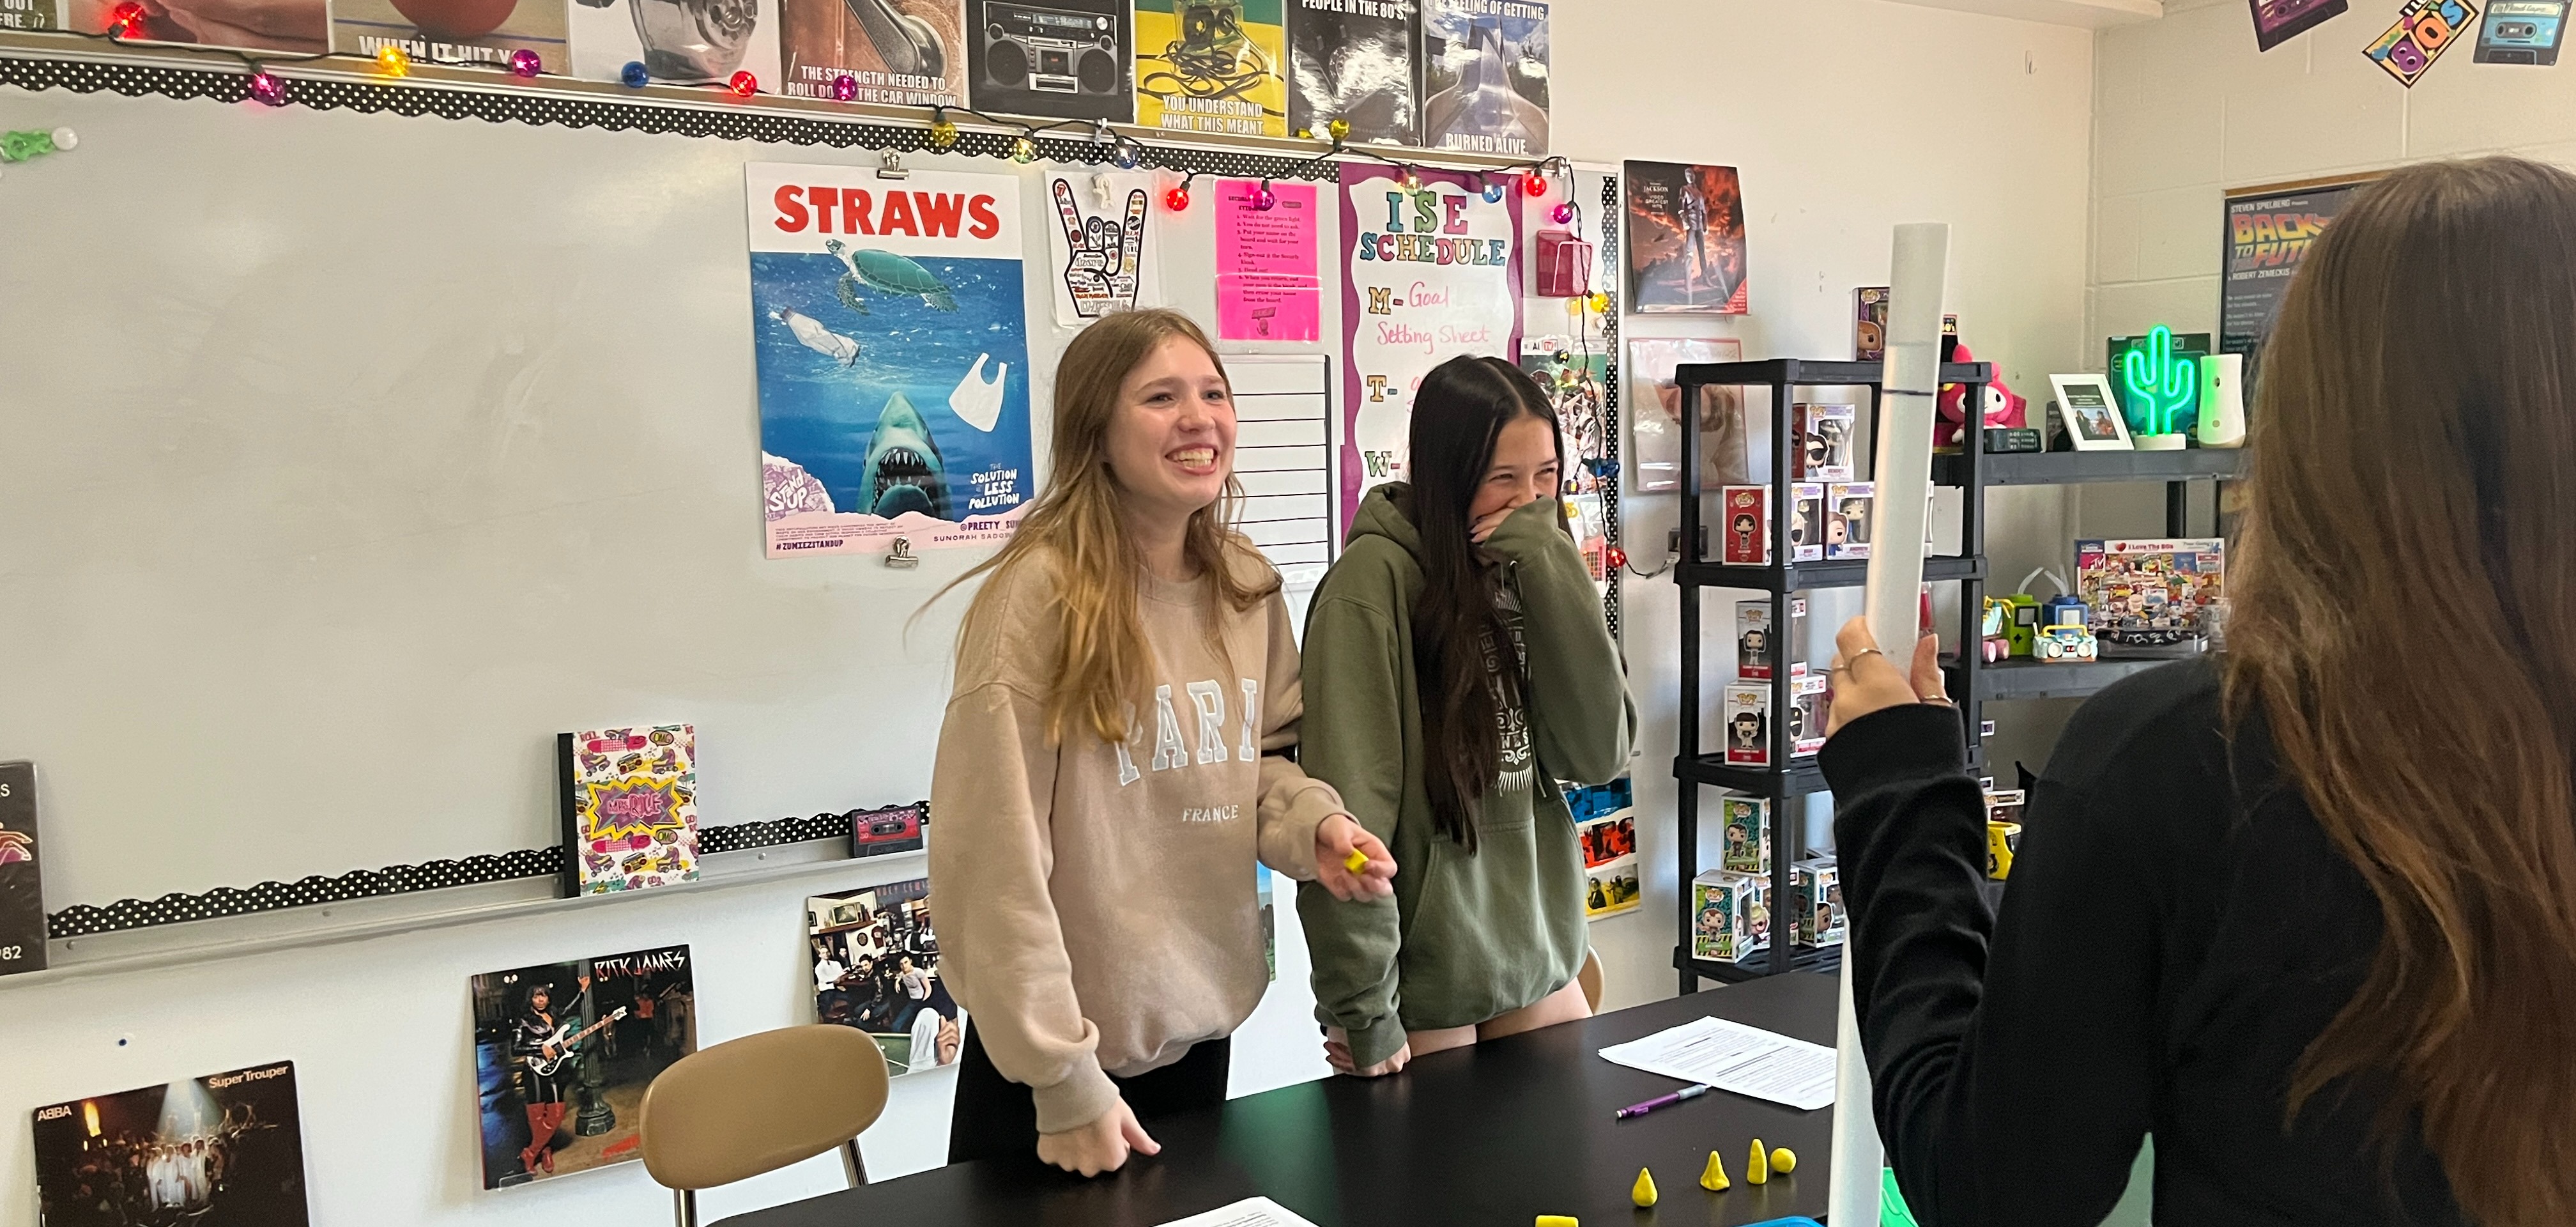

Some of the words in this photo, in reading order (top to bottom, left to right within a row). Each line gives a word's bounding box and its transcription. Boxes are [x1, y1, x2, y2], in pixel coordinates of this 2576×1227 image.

[1358, 1, 1379, 16] THE
[1489, 1, 1502, 16] OF
[1504, 3, 1545, 20] GETTING
[457, 45, 493, 63] HIT
[801, 65, 823, 81] THE
[887, 73, 929, 90] NEEDED
[931, 76, 946, 91] TO
[787, 82, 816, 98] ROLL
[818, 84, 834, 99] DO
[857, 88, 880, 103] THE
[880, 89, 904, 105] CAR
[905, 93, 957, 107] WINDOW
[1162, 95, 1186, 112] YOU
[1188, 96, 1263, 118] UNDERSTAND
[1160, 113, 1195, 130] WHAT
[1196, 116, 1224, 134] THIS
[1225, 118, 1266, 135] MEANT.
[1445, 132, 1493, 152] BURNED
[1496, 136, 1530, 155] ALIVE.
[774, 185, 1000, 240] STRAWS
[2231, 204, 2255, 213] STEVEN
[2256, 199, 2290, 211] SPIELBERG
[2232, 213, 2323, 245] BACK
[1360, 231, 1506, 267] SCHEDULE
[2235, 244, 2254, 259] TO
[2252, 239, 2313, 268] FUT
[2232, 271, 2257, 281] ROBERT
[1409, 281, 1449, 309] Goal
[1377, 321, 1434, 355] Setting
[1439, 324, 1492, 344] Sheet
[970, 468, 1017, 484] SOLUTION
[786, 486, 808, 509] UP
[985, 480, 1014, 496] LESS
[969, 493, 1020, 510] POLLUTION
[1183, 805, 1239, 822] FRANCE
[0, 946, 22, 960] 82
[595, 957, 634, 979] RICK
[634, 950, 686, 975] JAMES
[209, 1074, 244, 1090] Super
[243, 1065, 288, 1084] Trouper
[37, 1105, 72, 1122] ABBA
